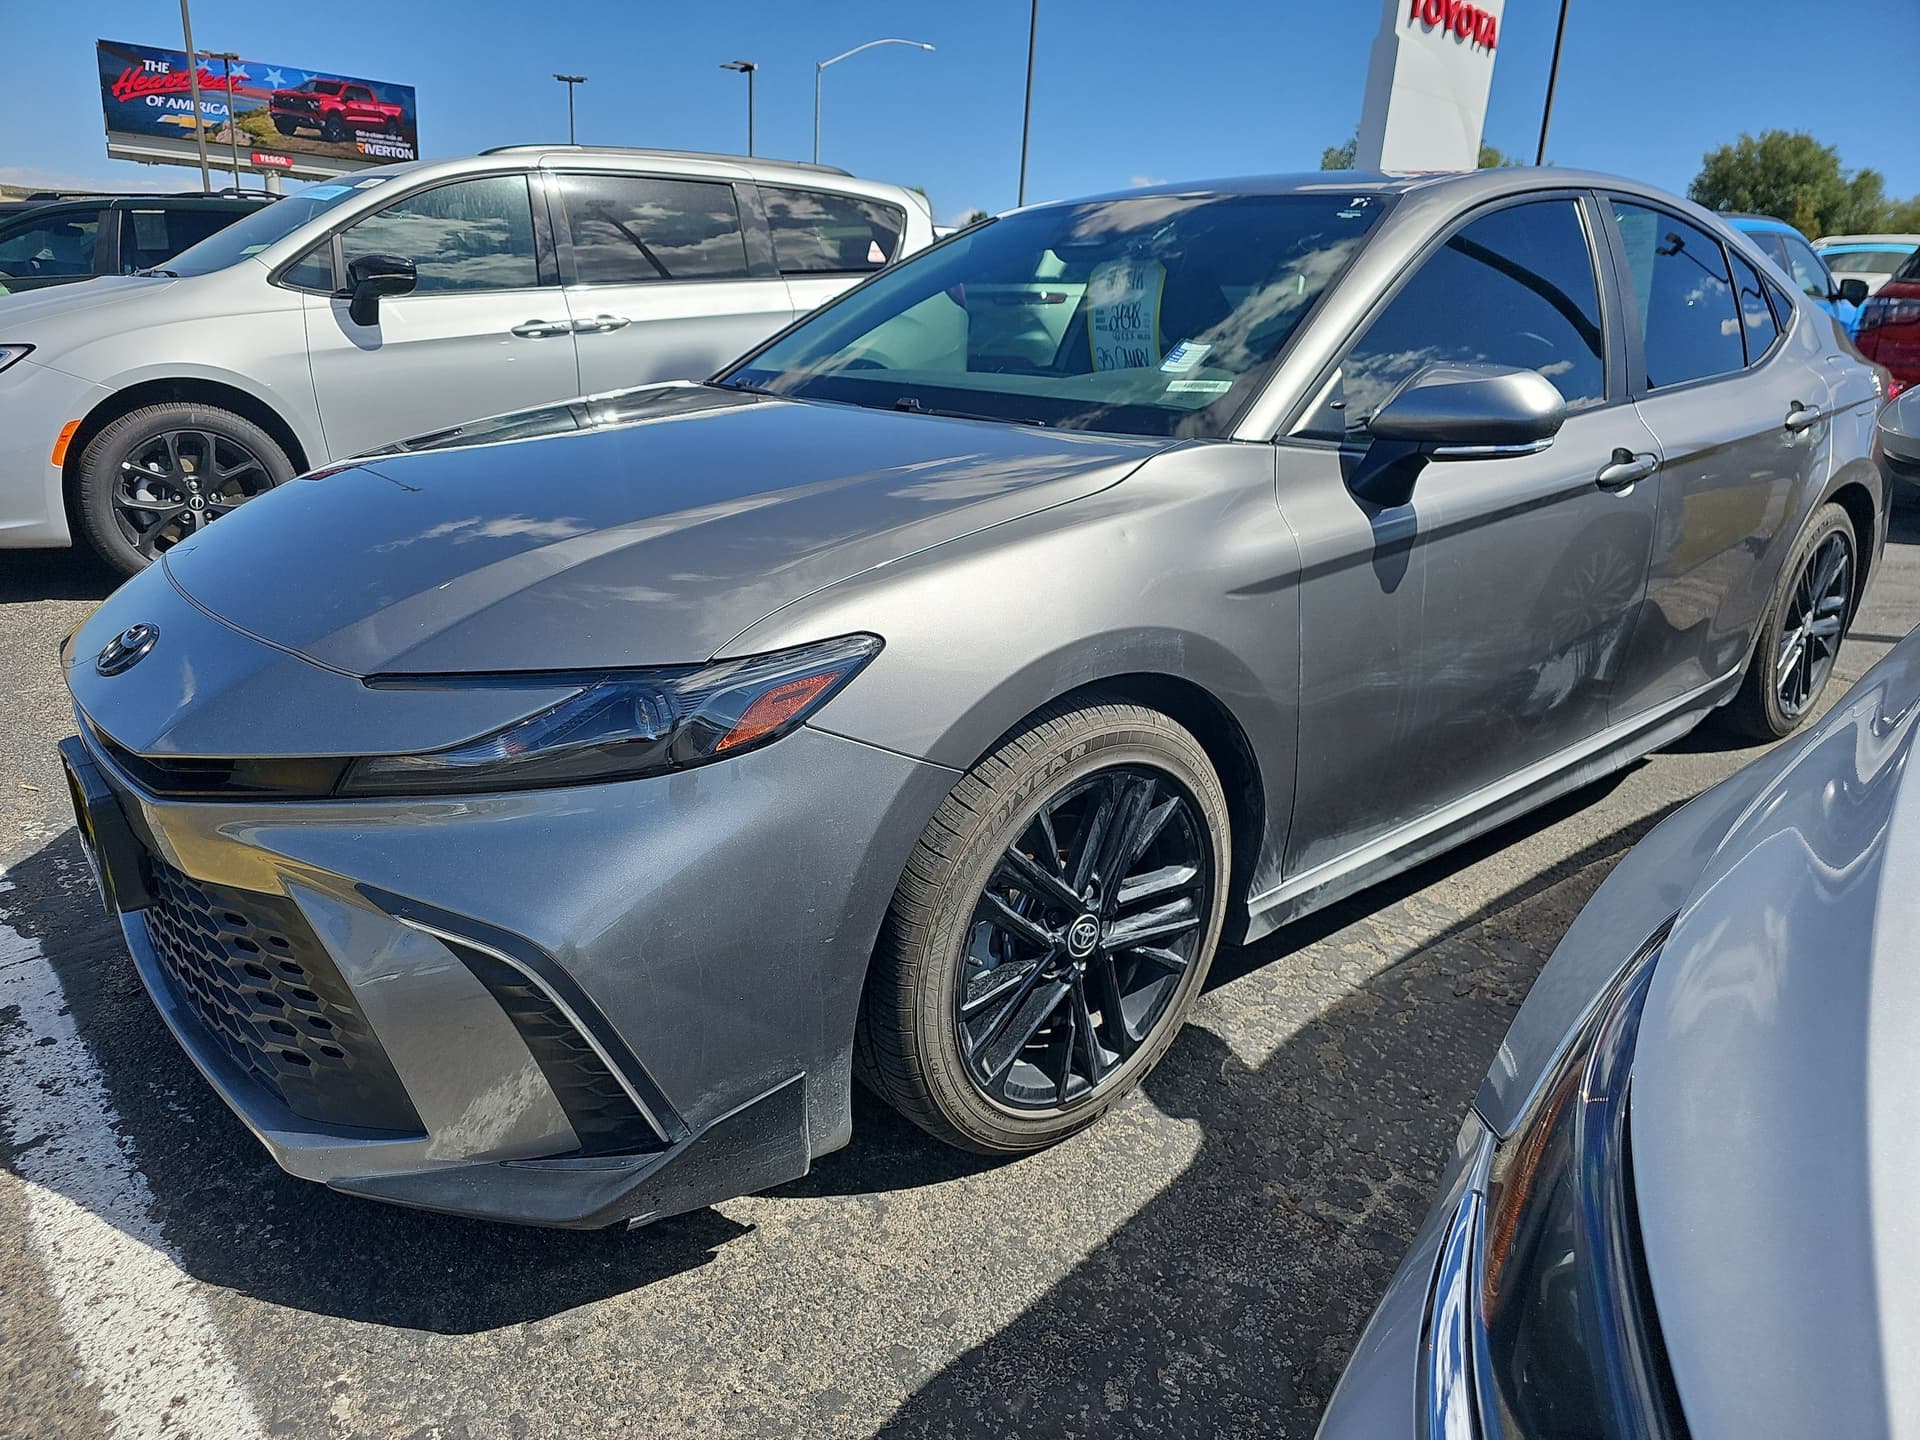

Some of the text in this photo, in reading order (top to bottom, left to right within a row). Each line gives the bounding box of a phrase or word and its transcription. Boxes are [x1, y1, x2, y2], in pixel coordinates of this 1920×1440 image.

[143, 59, 170, 74] THE
[145, 95, 165, 107] OF
[356, 142, 414, 161] RIVERTON
